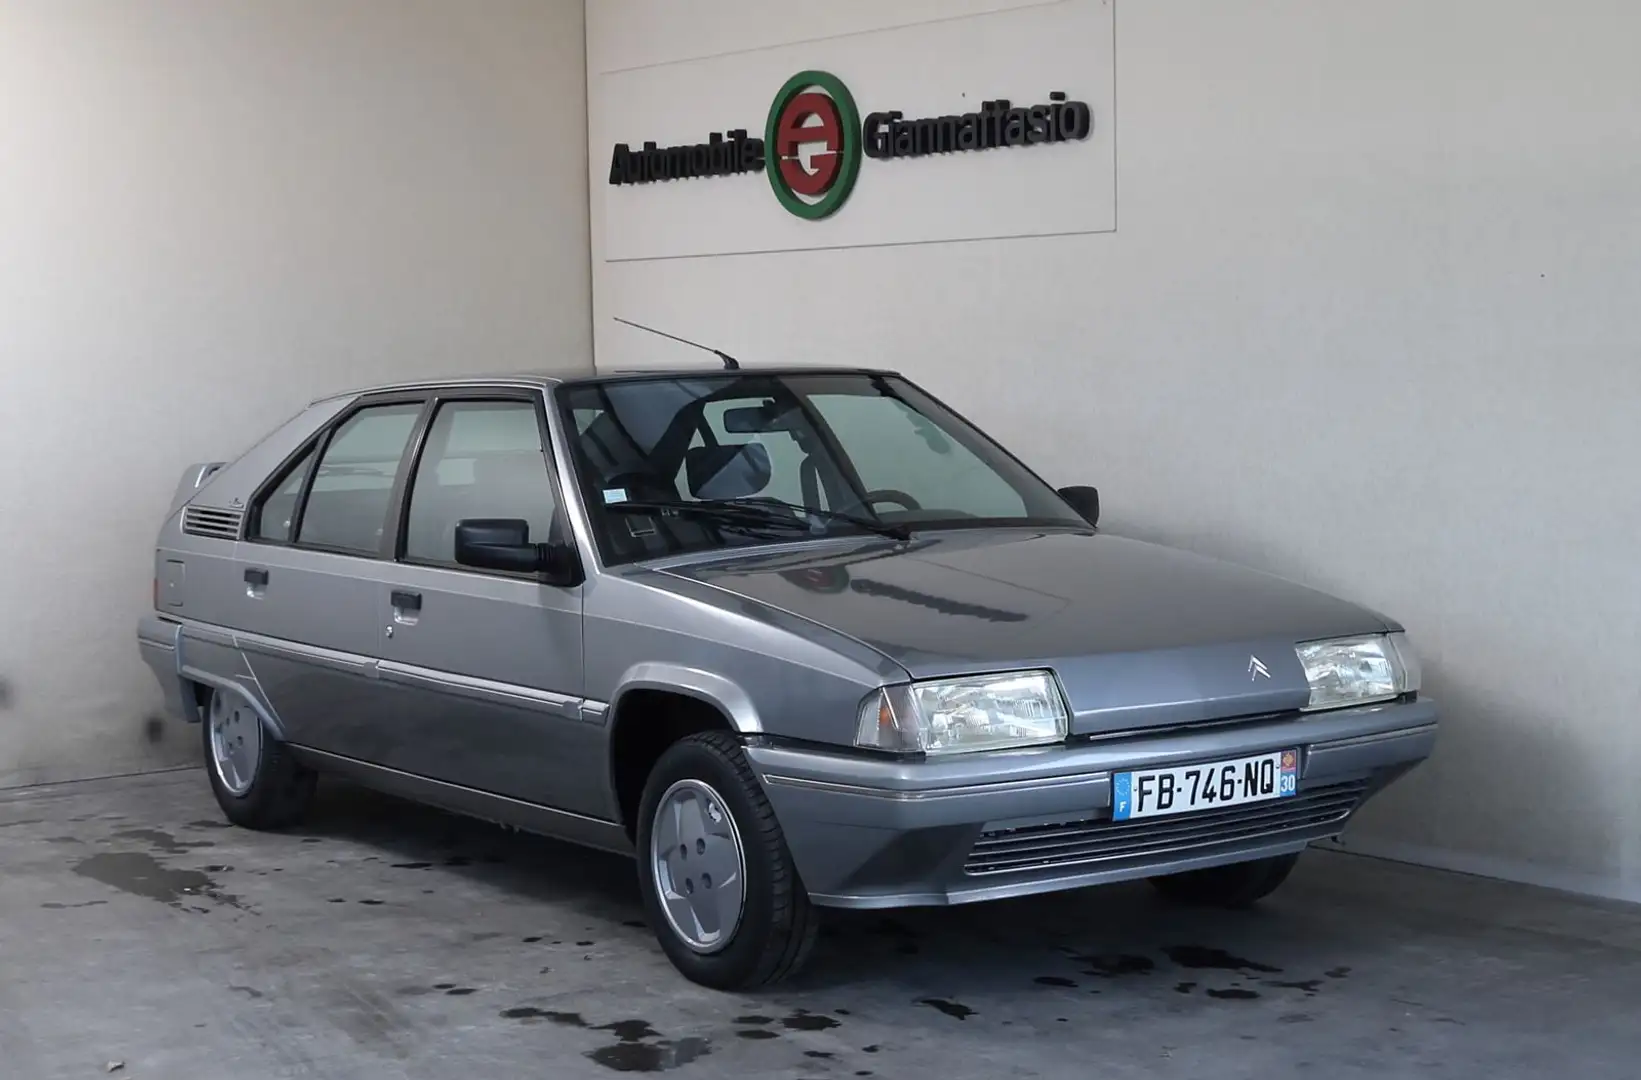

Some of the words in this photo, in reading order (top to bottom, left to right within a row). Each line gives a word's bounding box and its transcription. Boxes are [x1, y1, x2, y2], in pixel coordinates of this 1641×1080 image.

[609, 129, 765, 185] Automobile
[1137, 758, 1274, 812] FB-746-NQ
[1280, 774, 1296, 792] 30
[1119, 801, 1127, 812] F
